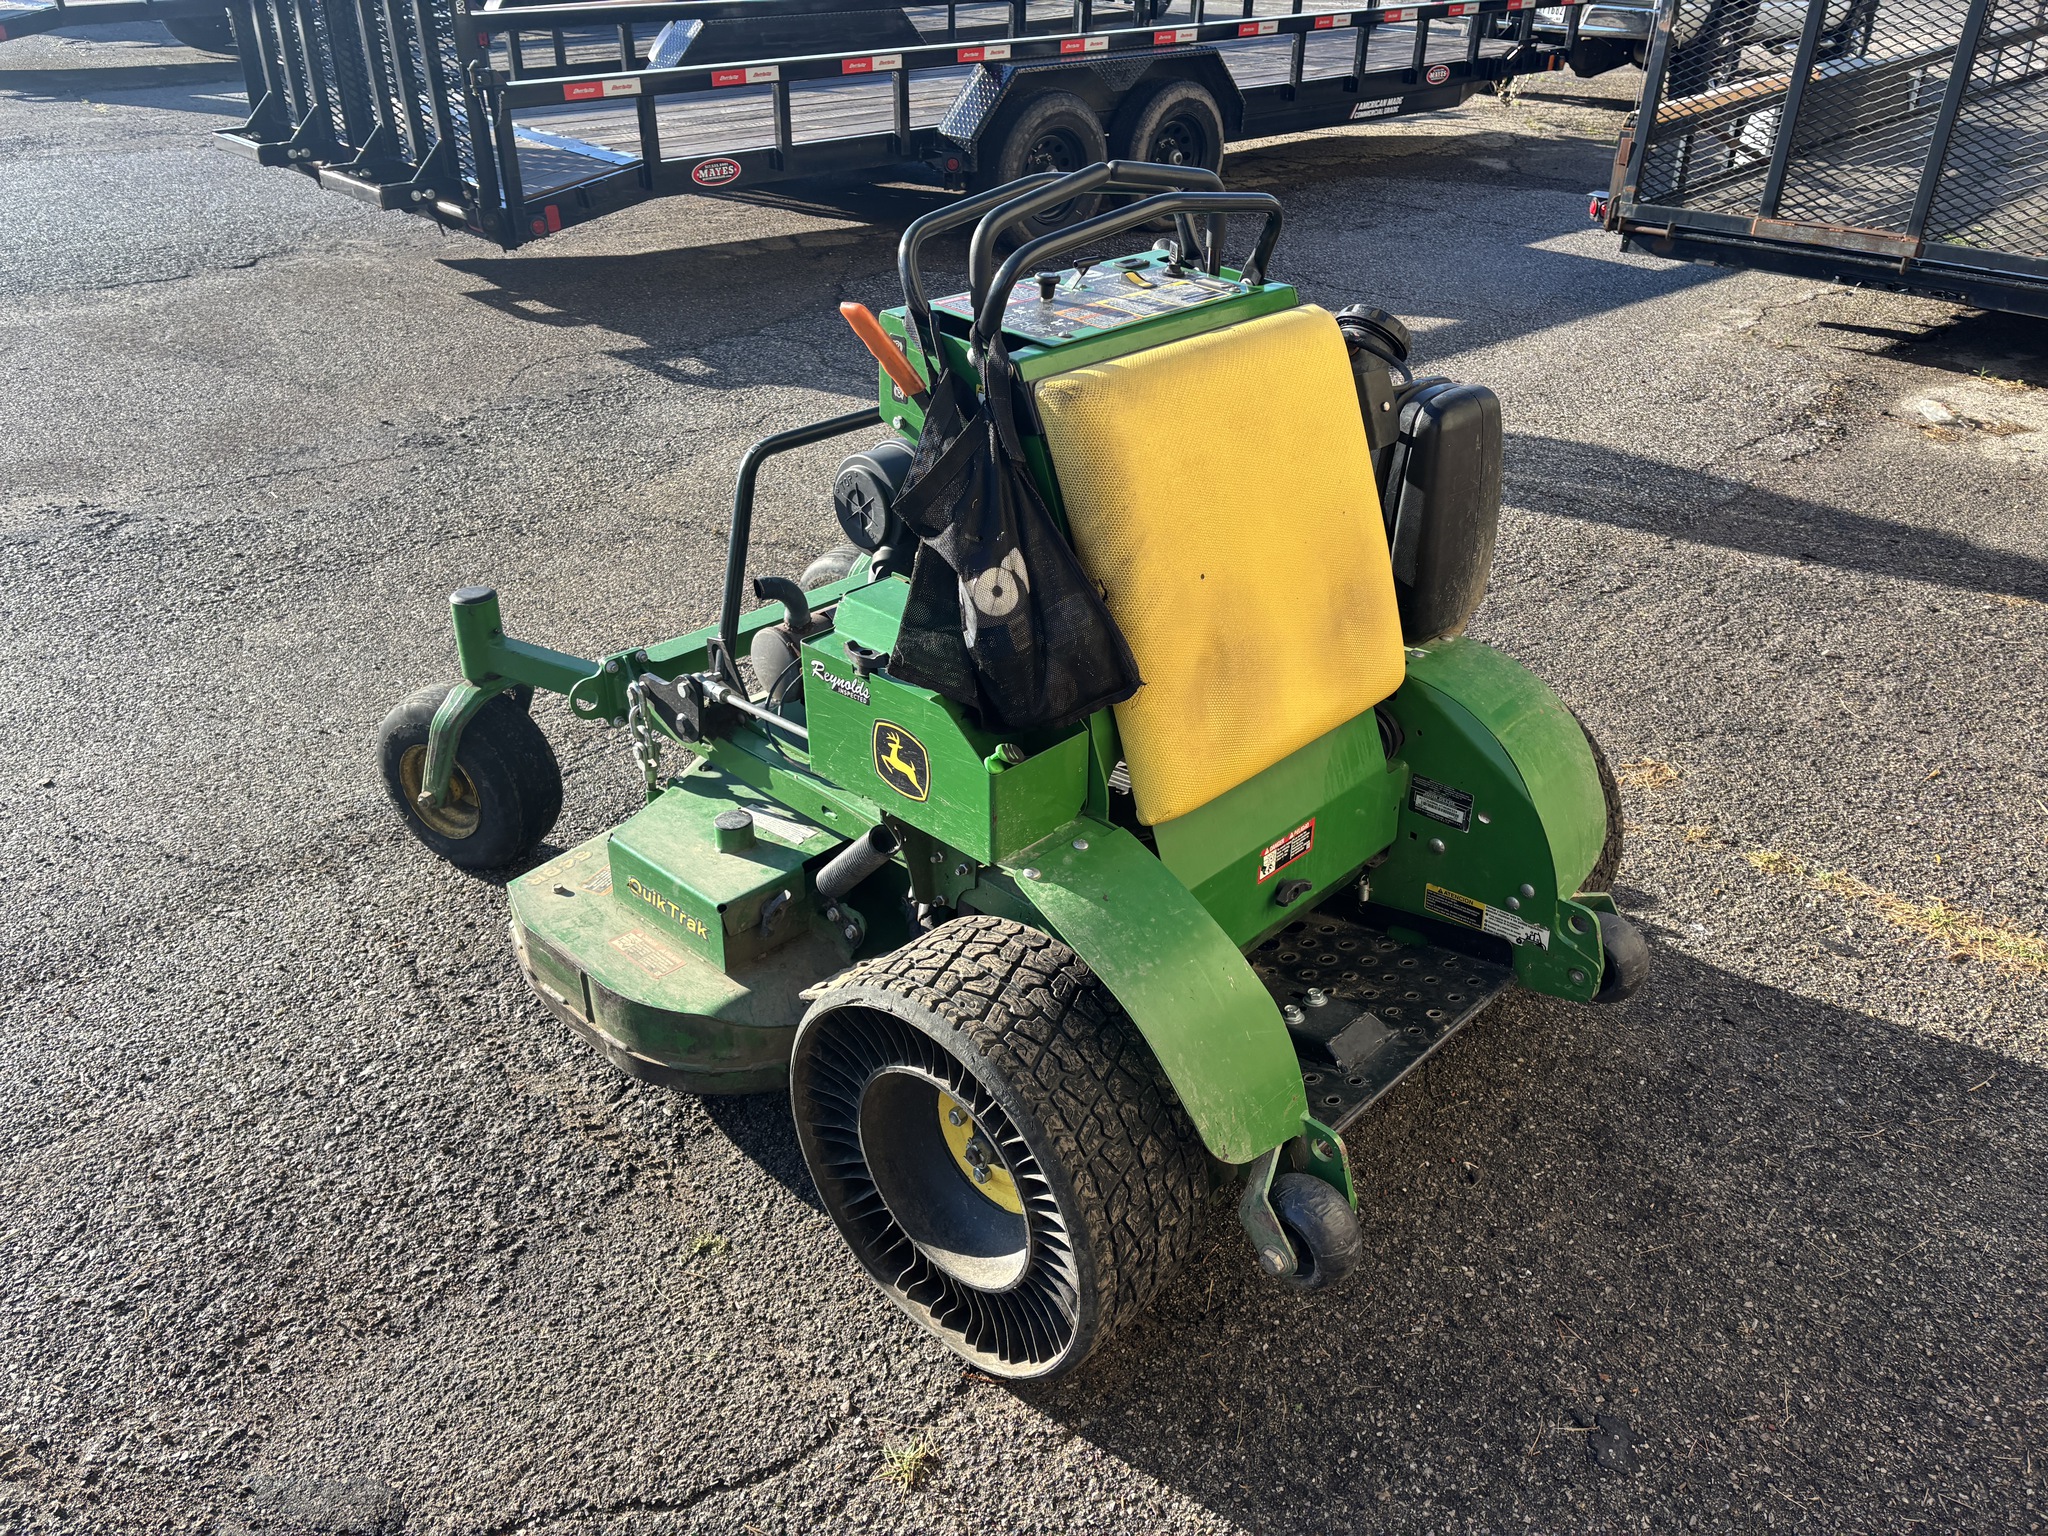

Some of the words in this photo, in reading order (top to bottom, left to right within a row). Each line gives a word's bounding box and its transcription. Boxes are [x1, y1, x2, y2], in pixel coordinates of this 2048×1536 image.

[1358, 99, 1387, 110] AMERICAN
[1387, 96, 1404, 106] MADE
[1354, 108, 1384, 119] COMMERCIAL
[1384, 106, 1400, 114] GRADE
[698, 165, 734, 178] MAYES
[840, 478, 853, 490] TOP
[810, 658, 871, 699] Reynolds
[838, 688, 867, 704] INSPECTED
[628, 876, 710, 942] QuikTrak
